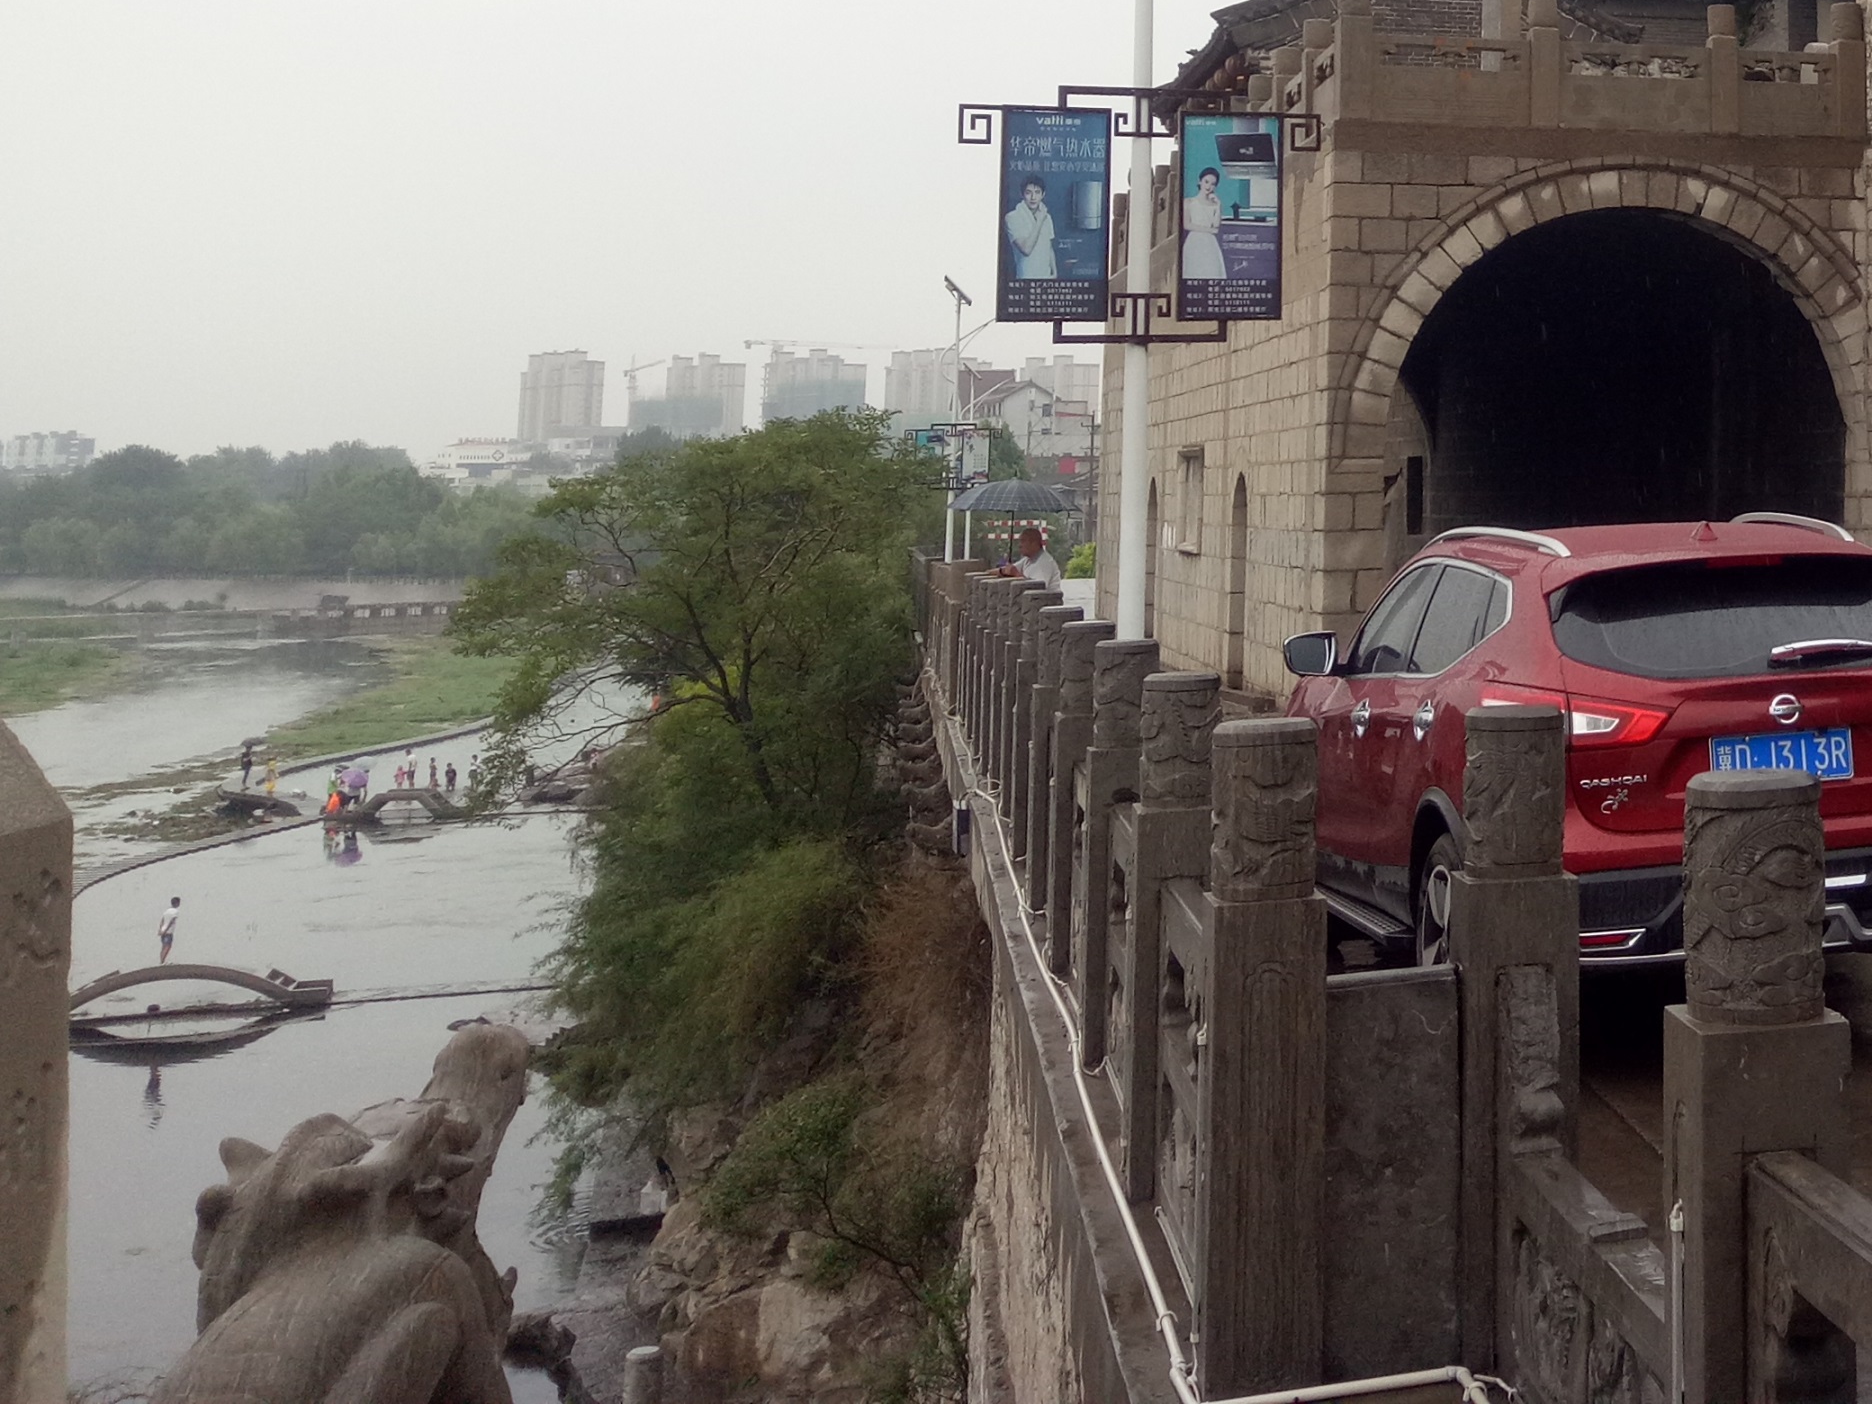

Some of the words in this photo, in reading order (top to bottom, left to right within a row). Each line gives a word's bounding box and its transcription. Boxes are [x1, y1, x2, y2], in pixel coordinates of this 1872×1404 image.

[1009, 136, 1105, 158] 华帝燃气热水器
[1579, 774, 1649, 790] QASHQAI
